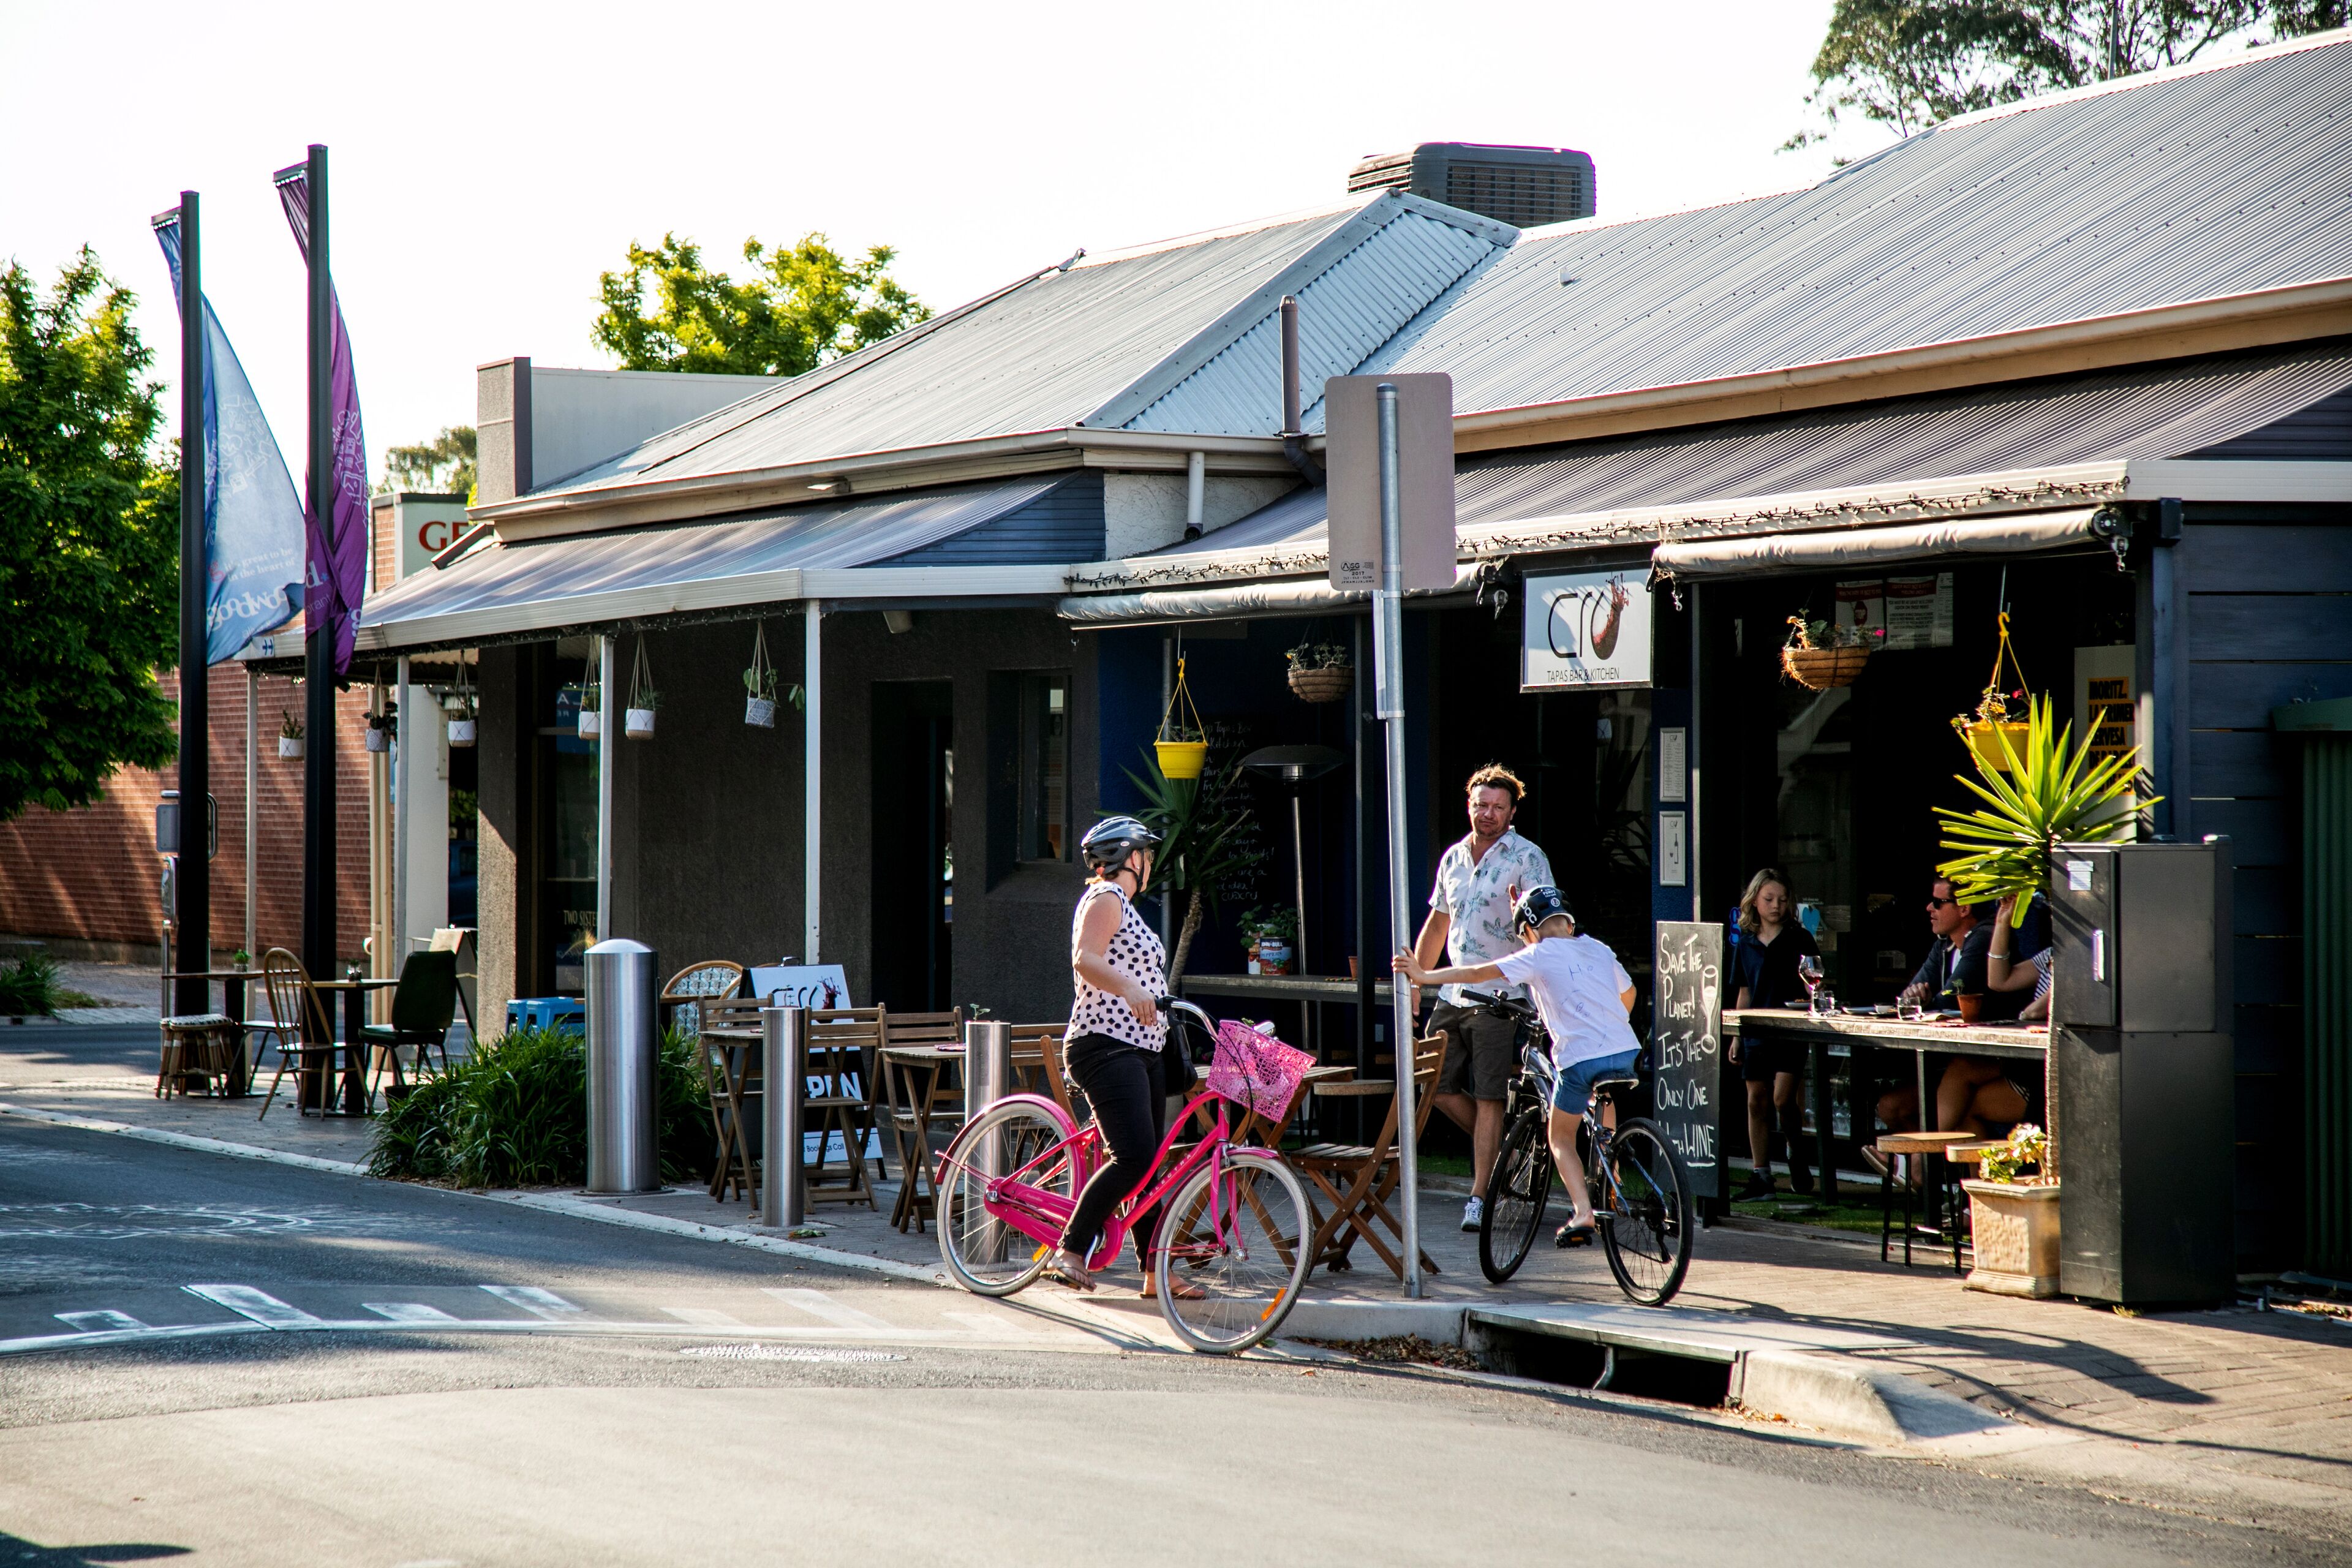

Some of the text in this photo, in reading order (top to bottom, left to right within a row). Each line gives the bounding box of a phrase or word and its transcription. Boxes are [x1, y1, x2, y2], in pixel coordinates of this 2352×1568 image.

[281, 548, 293, 556] be
[240, 569, 255, 579] the
[257, 565, 282, 575] heart
[1547, 667, 1620, 683] TAPAS BAR & KITCHEN
[2088, 680, 2127, 700] MORITZ.
[562, 910, 578, 925] TWO
[579, 910, 597, 927] SISTE
[1521, 901, 1537, 924] POC
[1659, 932, 1703, 976] SAVE THE
[1662, 975, 1695, 1021] PLANET!
[1681, 1030, 1703, 1063] THE
[805, 1072, 863, 1102] PN
[1657, 1077, 1709, 1110] ONLY ONE
[806, 1143, 832, 1153] Boogs
[1684, 1122, 1716, 1159] WINE
[1148, 1153, 1192, 1197] ELECTRA
